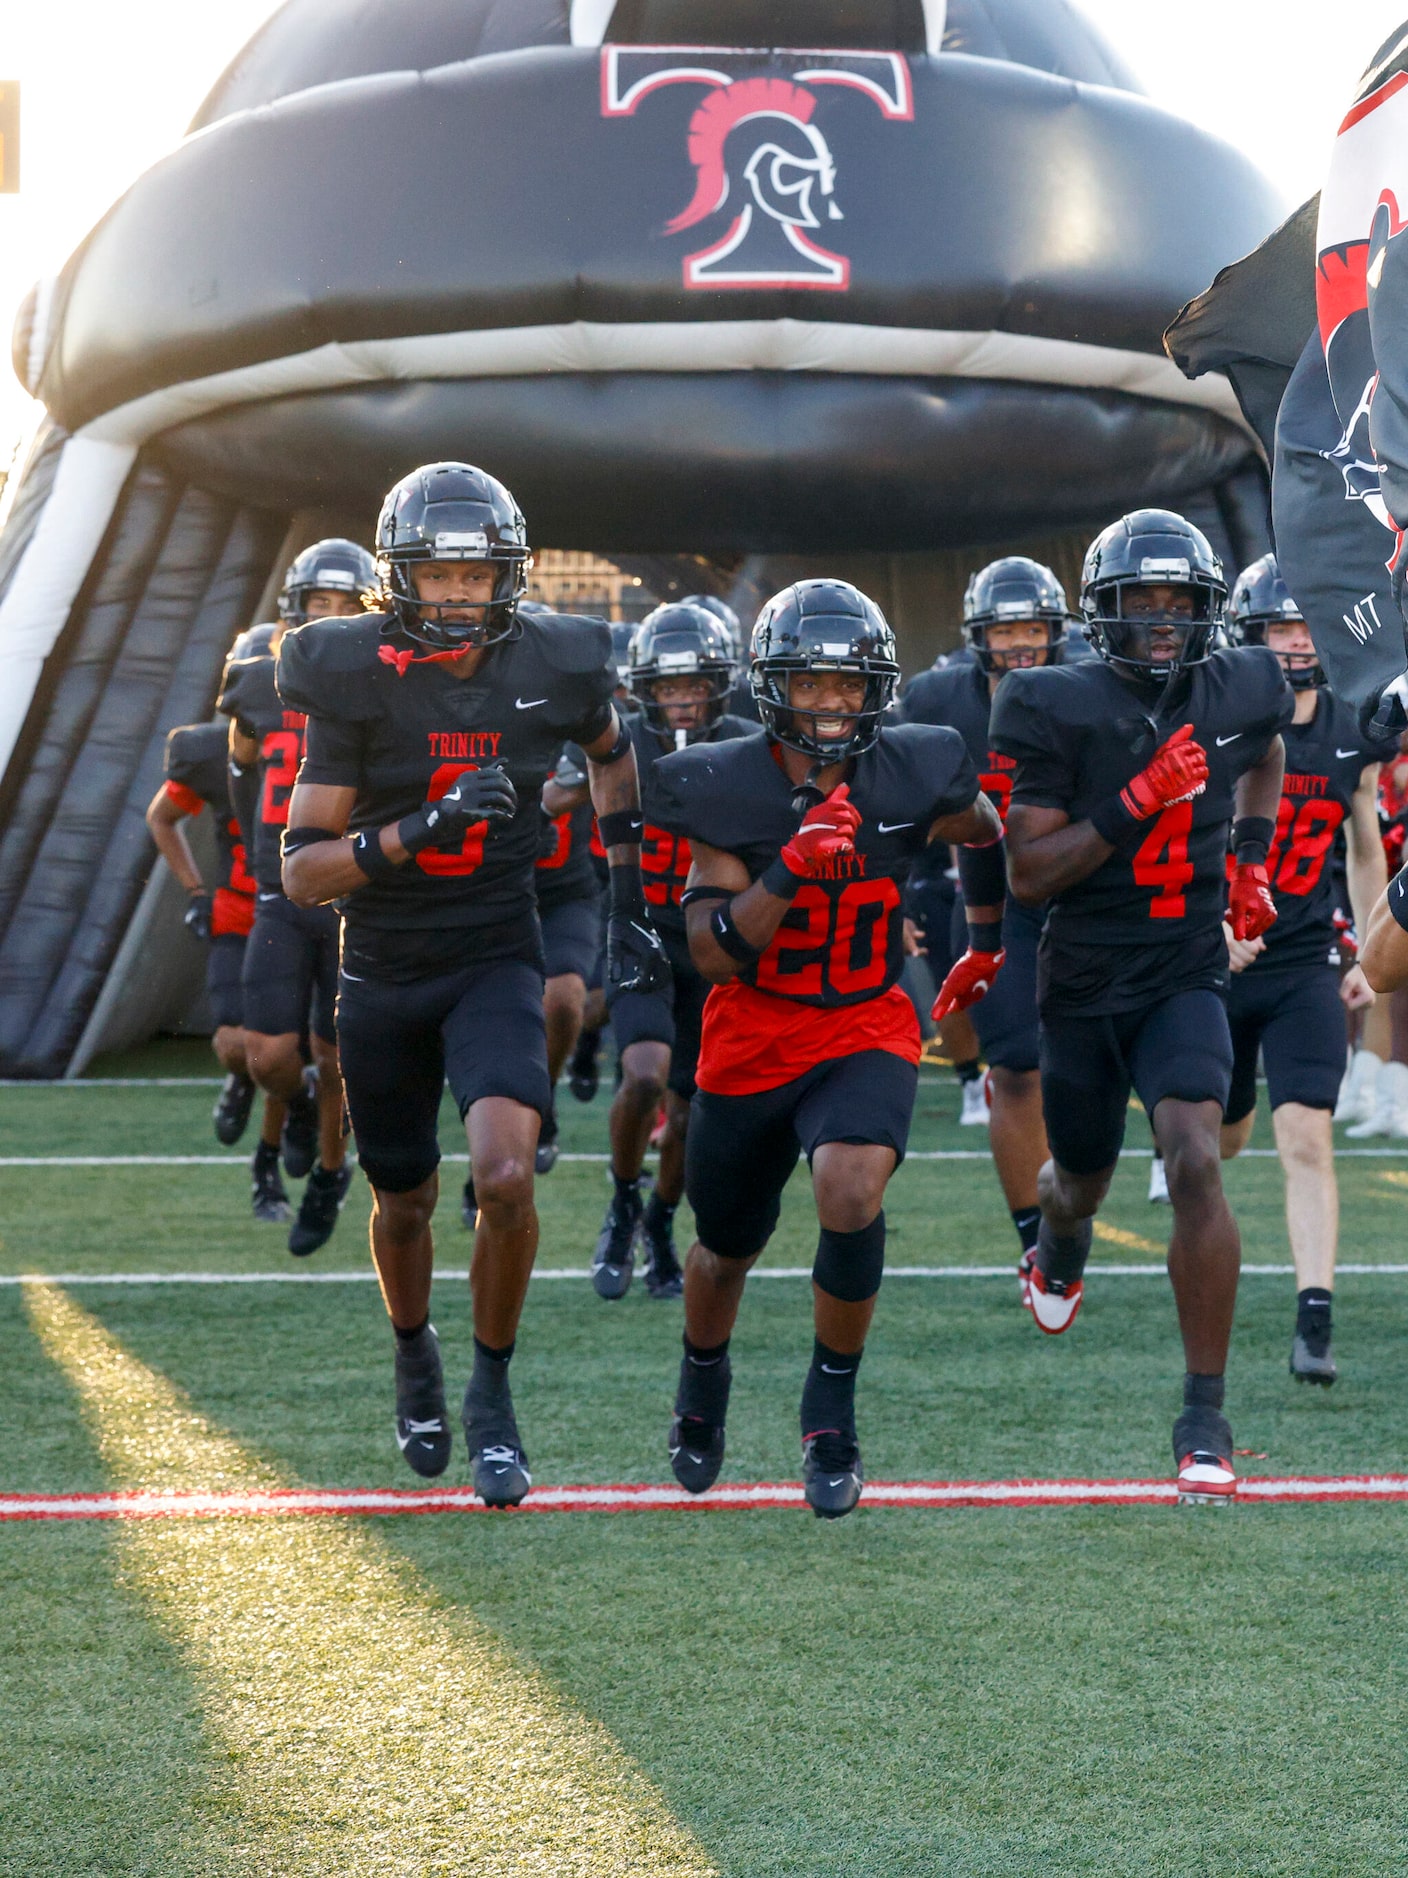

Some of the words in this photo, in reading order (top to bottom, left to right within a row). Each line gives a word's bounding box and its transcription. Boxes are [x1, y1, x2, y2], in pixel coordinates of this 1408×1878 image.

[1342, 592, 1382, 646] MT
[427, 732, 502, 758] TRINITY
[1282, 773, 1330, 796] RINITY
[1131, 800, 1195, 919] 4
[757, 876, 901, 996] 20
